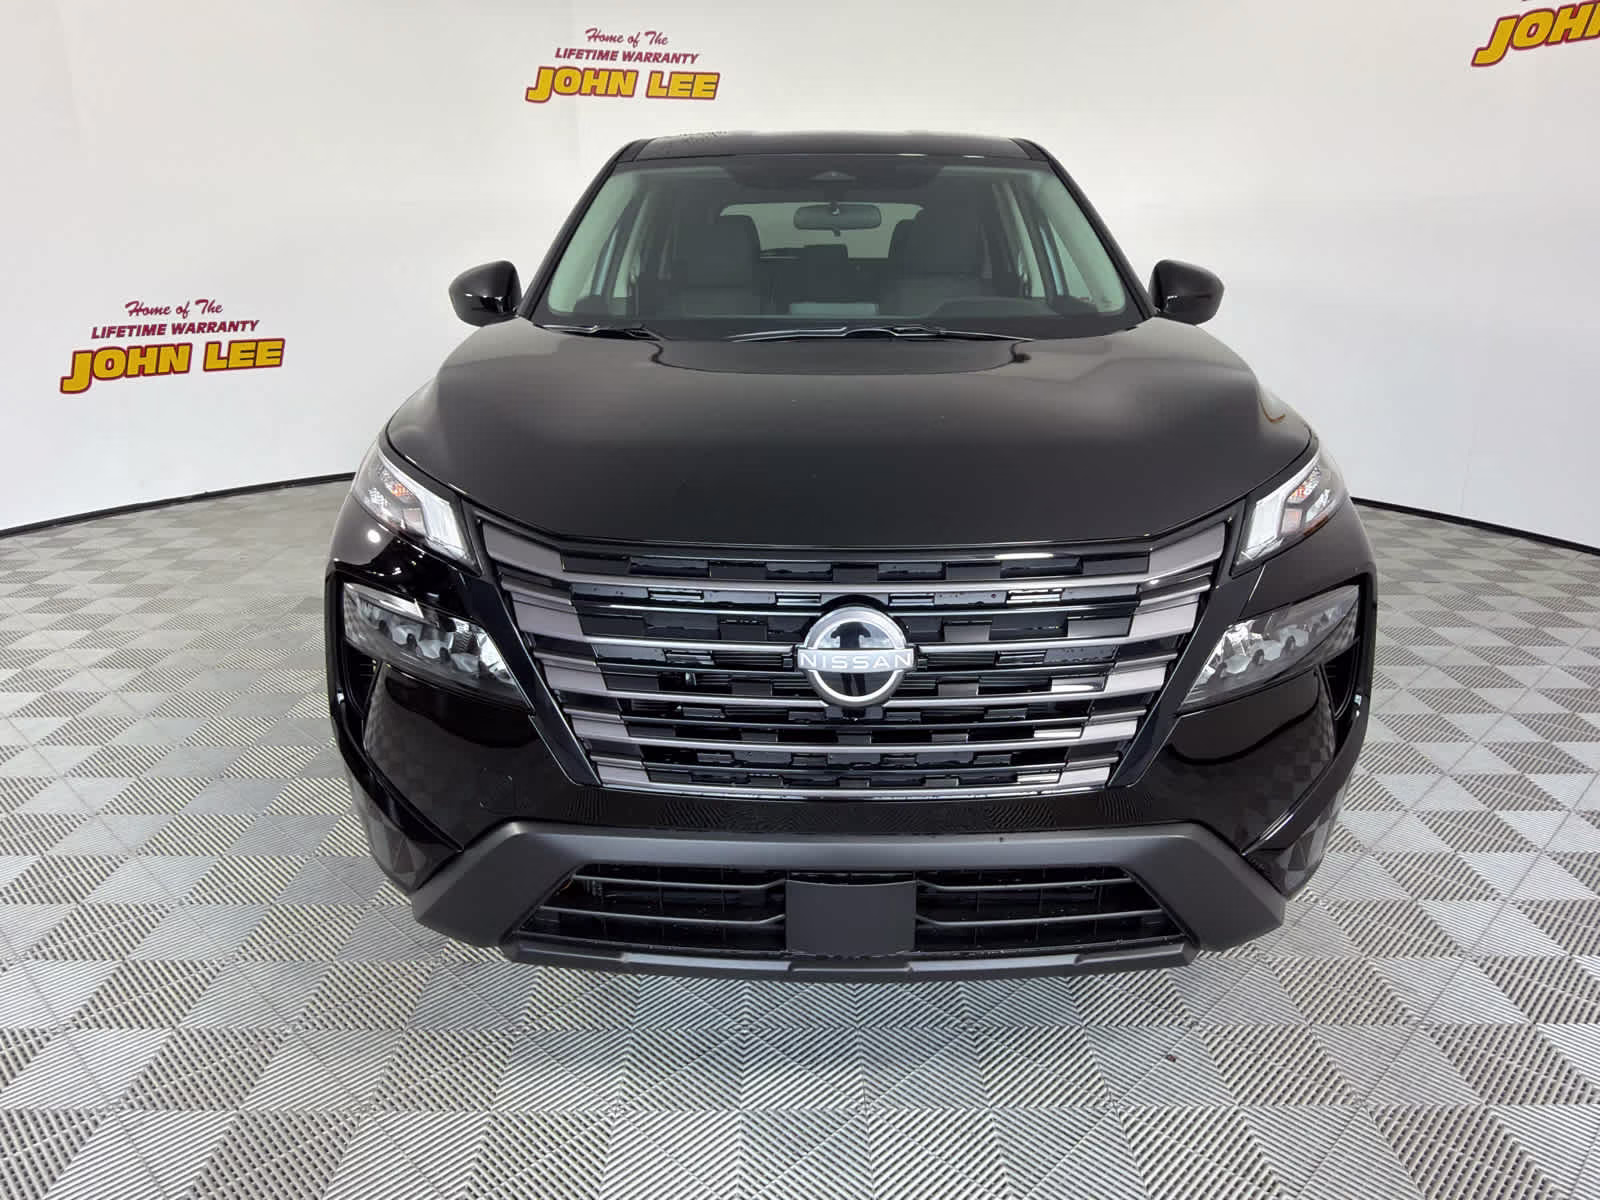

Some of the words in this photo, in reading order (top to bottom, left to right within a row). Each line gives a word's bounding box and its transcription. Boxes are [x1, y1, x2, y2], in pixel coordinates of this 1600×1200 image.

[585, 28, 623, 42] Home
[627, 32, 641, 47] of
[645, 31, 668, 46] The
[555, 48, 619, 62] LIFETIME
[622, 51, 699, 65] WARRANTY
[525, 66, 639, 104] JOHN
[646, 70, 720, 100] LEE
[125, 301, 170, 317] Home
[175, 302, 190, 319] of
[195, 299, 223, 315] The
[91, 324, 167, 339] LIFETIME
[171, 320, 260, 335] WARRANTY
[60, 343, 192, 394] JOHN
[203, 338, 285, 372] LEE
[800, 653, 912, 669] NISSAN
